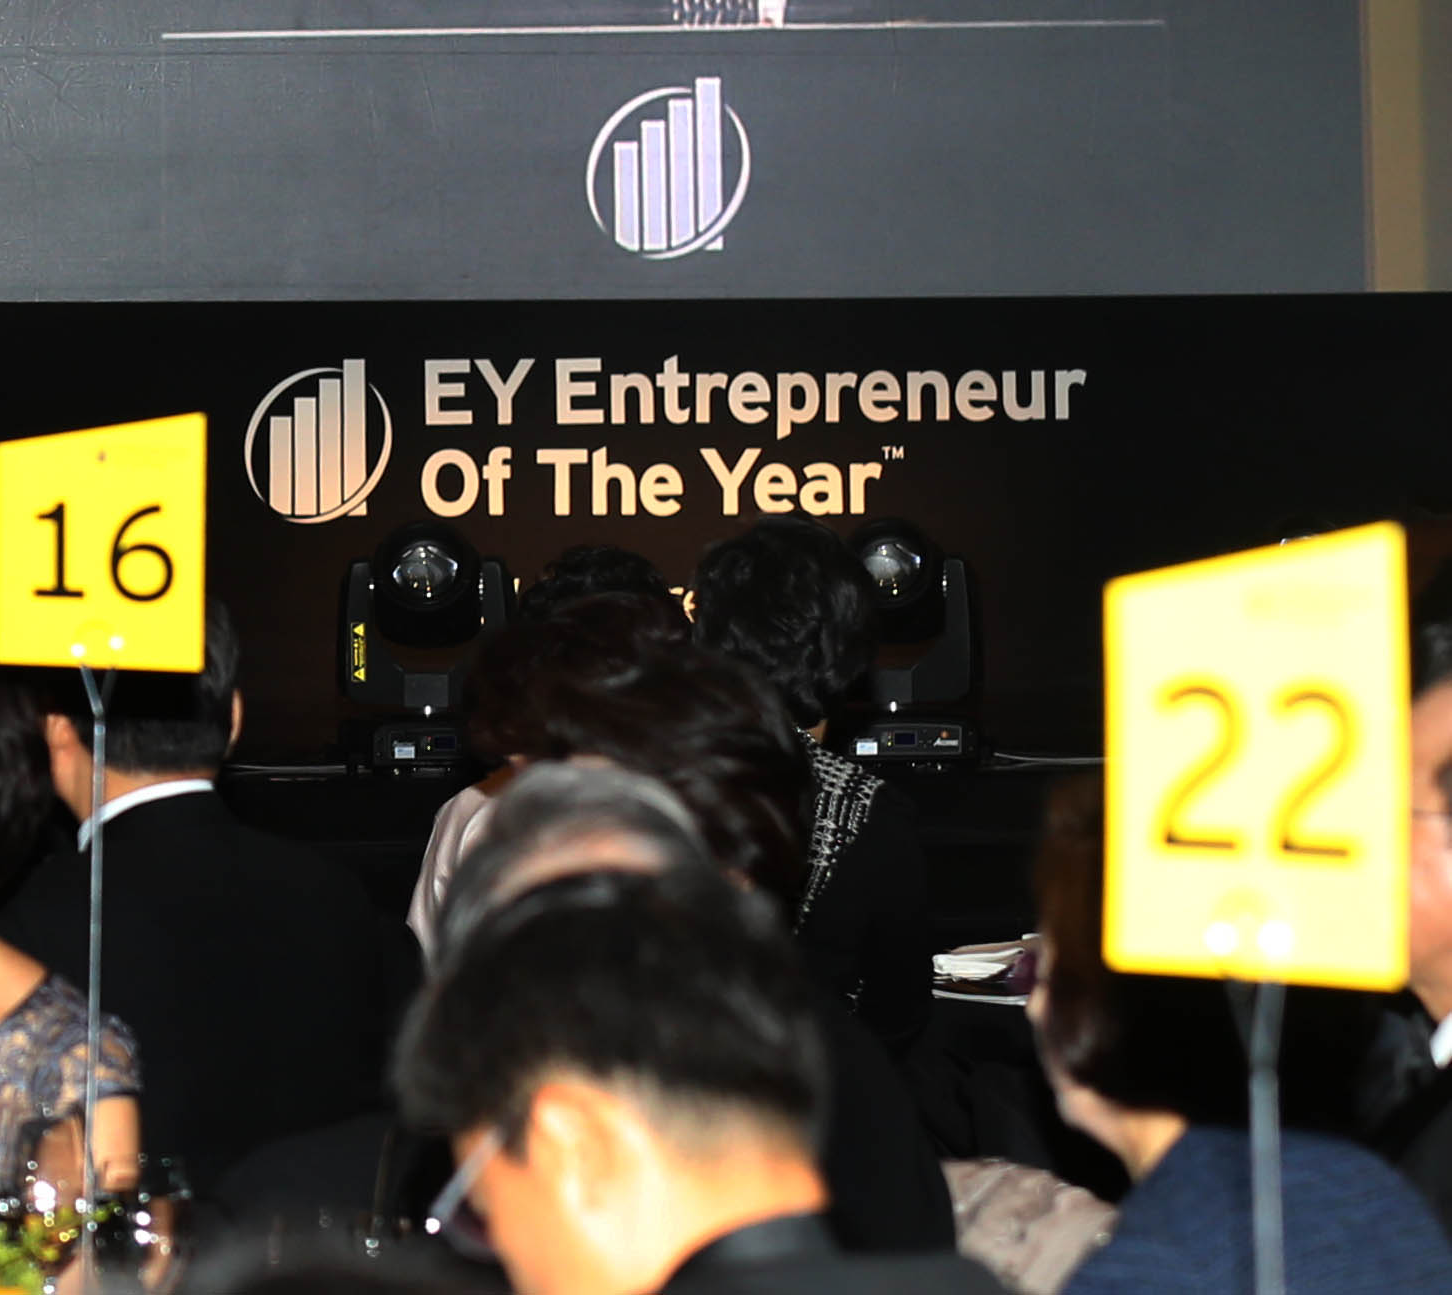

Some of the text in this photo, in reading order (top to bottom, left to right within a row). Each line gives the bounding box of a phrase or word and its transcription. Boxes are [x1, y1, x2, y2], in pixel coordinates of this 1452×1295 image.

[425, 356, 1088, 441] EY Entrepreneur
[421, 447, 513, 517] Of
[537, 447, 685, 518] The
[34, 503, 175, 604] 16
[1159, 681, 1357, 859] 22
